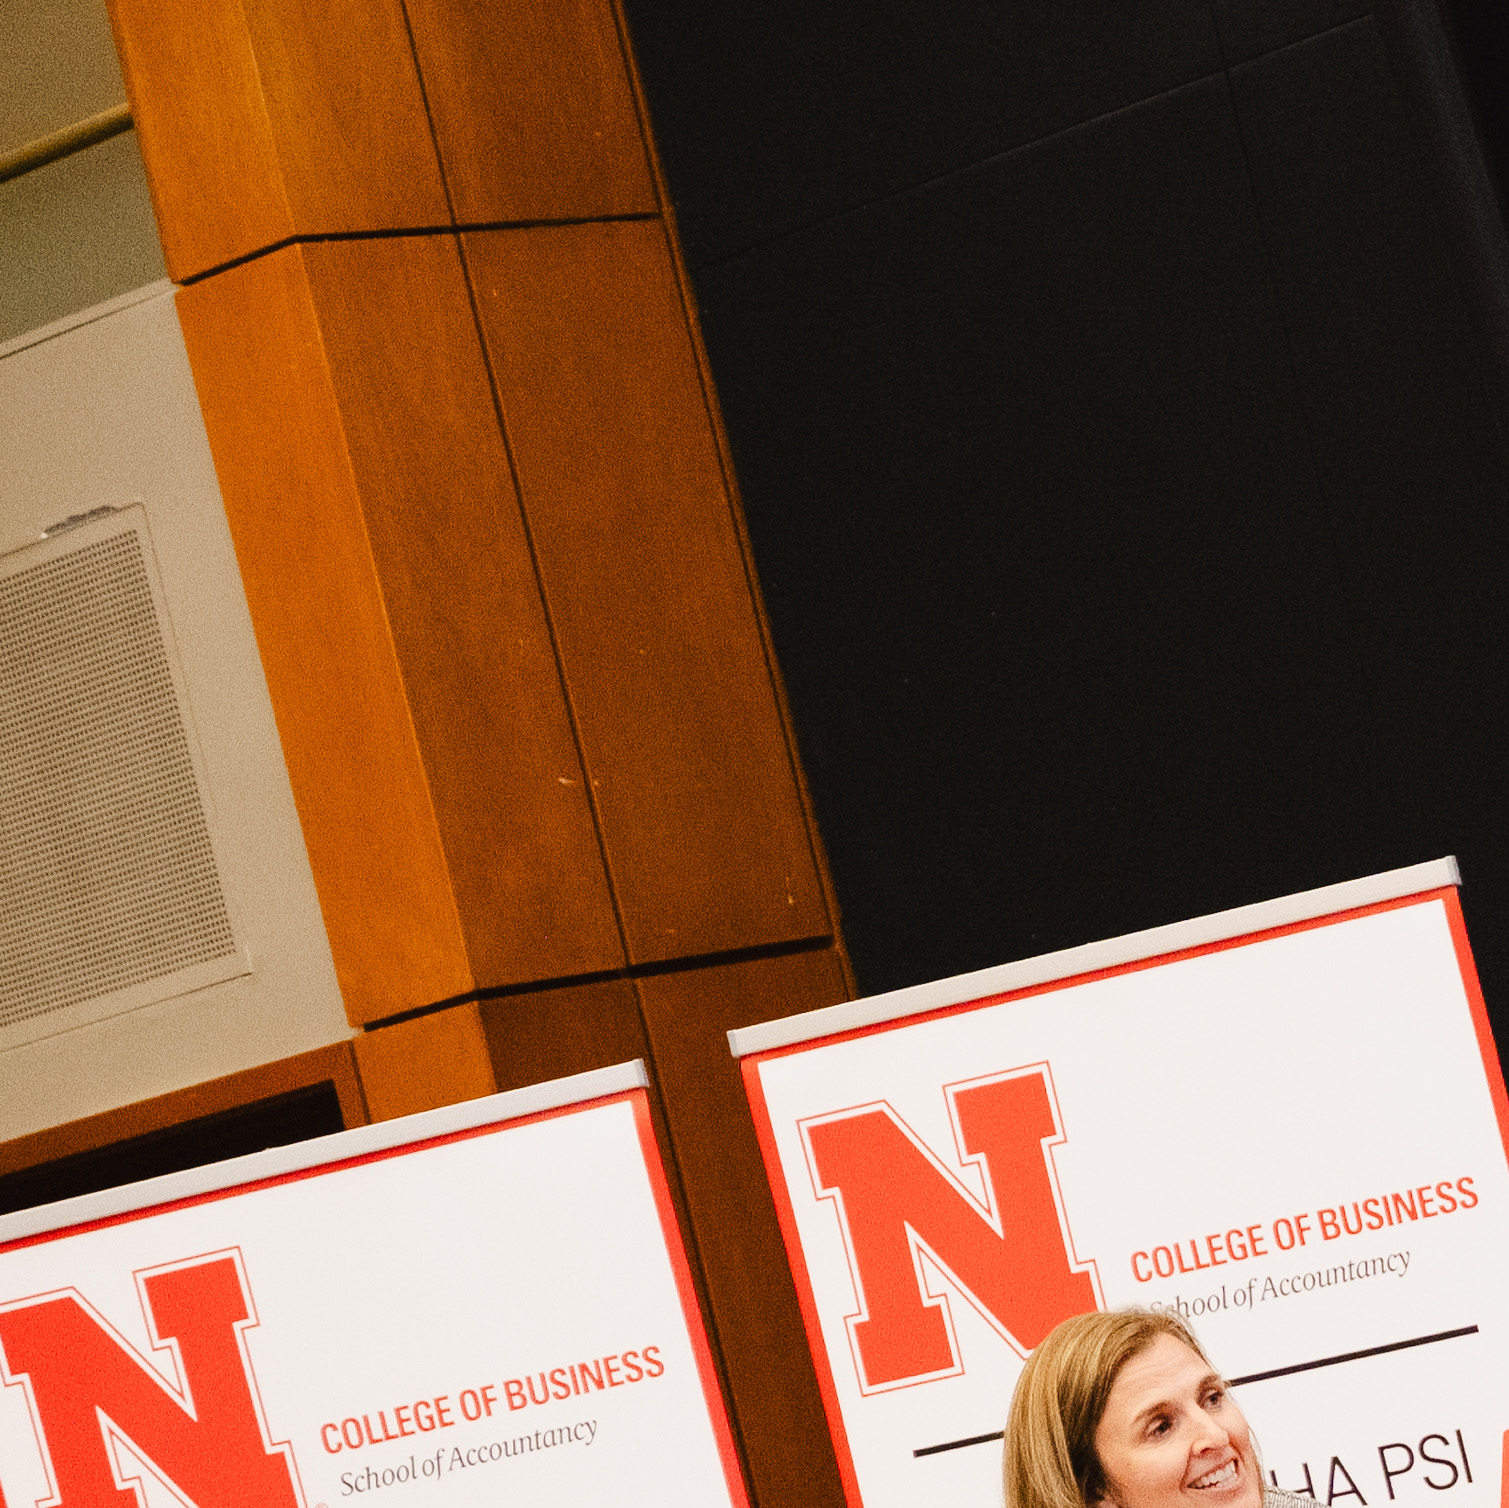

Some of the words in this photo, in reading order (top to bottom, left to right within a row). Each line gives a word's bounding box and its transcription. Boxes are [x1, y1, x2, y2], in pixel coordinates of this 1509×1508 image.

[1130, 1225, 1269, 1283] COLLEGE
[1273, 1213, 1312, 1251] OF
[1317, 1176, 1480, 1242] BUSINESS
[1233, 1278, 1259, 1311] of
[1260, 1250, 1411, 1302] Accountancy
[320, 1395, 456, 1454] COLLEGE
[459, 1384, 499, 1422] OF
[503, 1345, 666, 1412] BUSINESS
[340, 1455, 418, 1497] School
[422, 1449, 446, 1481] of
[448, 1420, 598, 1473] Accountancy
[1378, 1429, 1475, 1500] PSI
